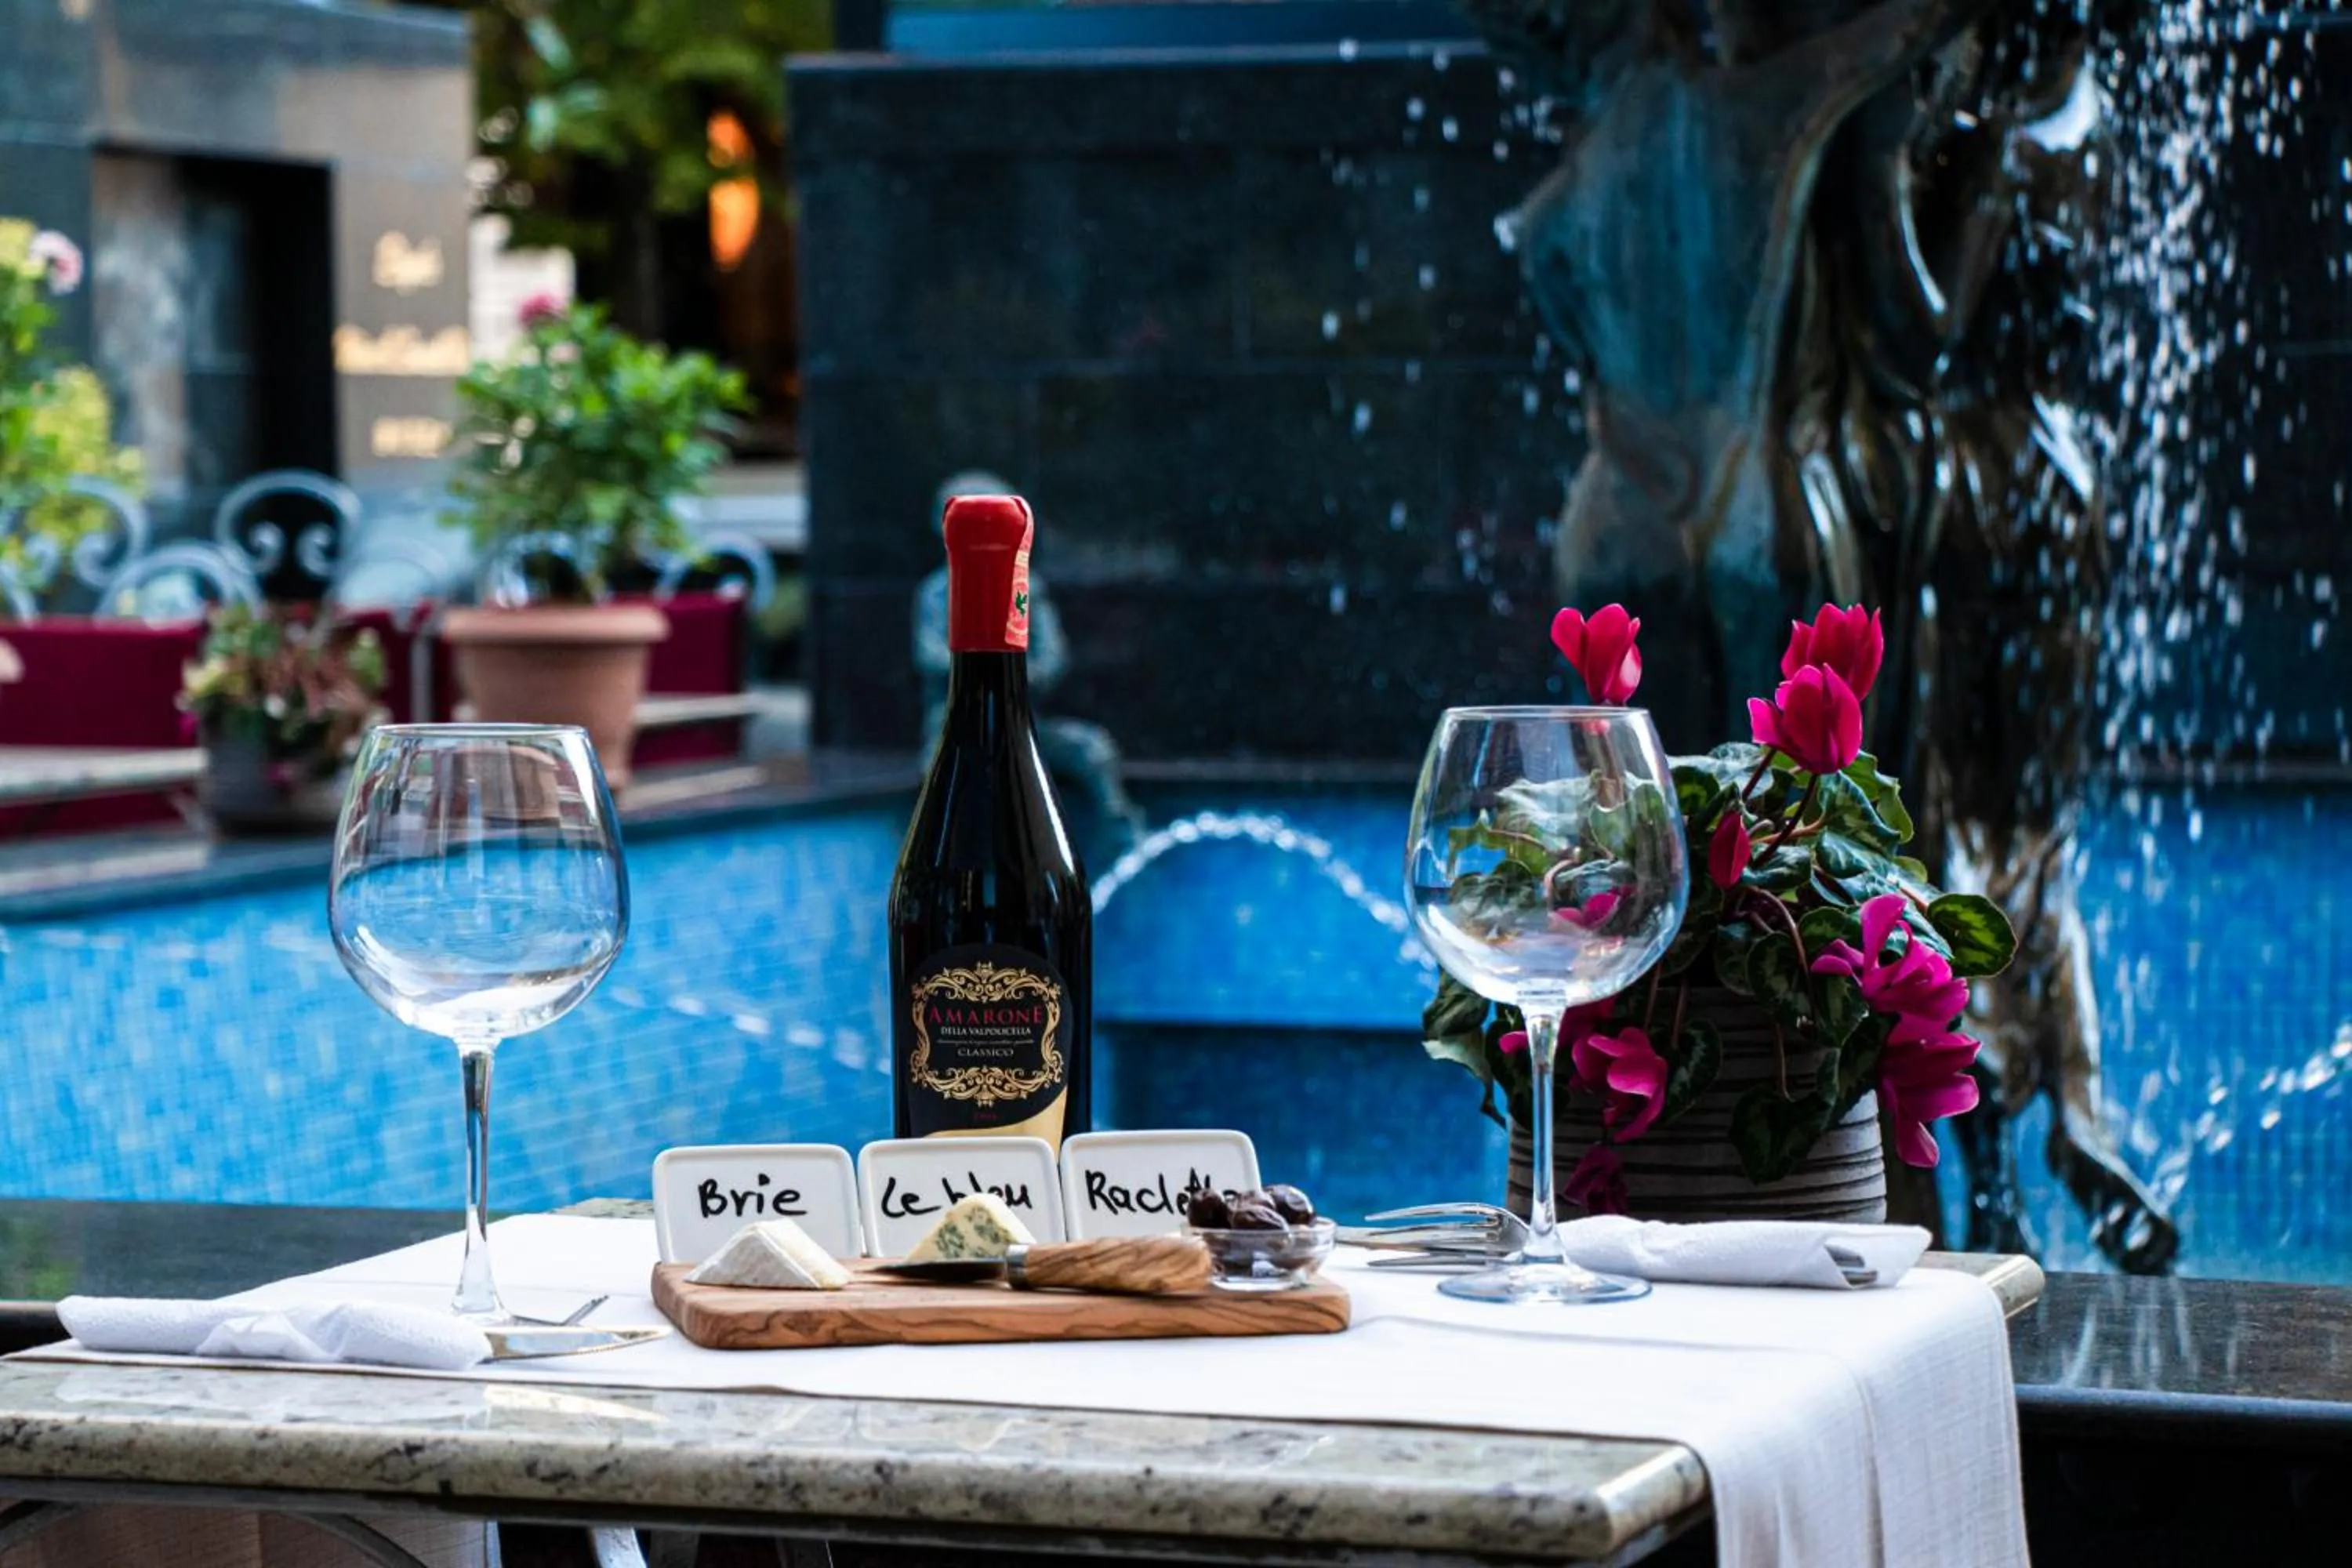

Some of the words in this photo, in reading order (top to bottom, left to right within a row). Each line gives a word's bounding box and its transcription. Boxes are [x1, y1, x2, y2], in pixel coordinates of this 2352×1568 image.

[929, 1005, 1044, 1025] AMARONE
[940, 1027, 967, 1036] DELLA
[968, 1027, 1032, 1036] VALPOLICELLA
[957, 1047, 1014, 1057] CLASSICO
[698, 1173, 808, 1218] Brie
[881, 1176, 942, 1218] Le
[1085, 1167, 1239, 1216] Raclet
